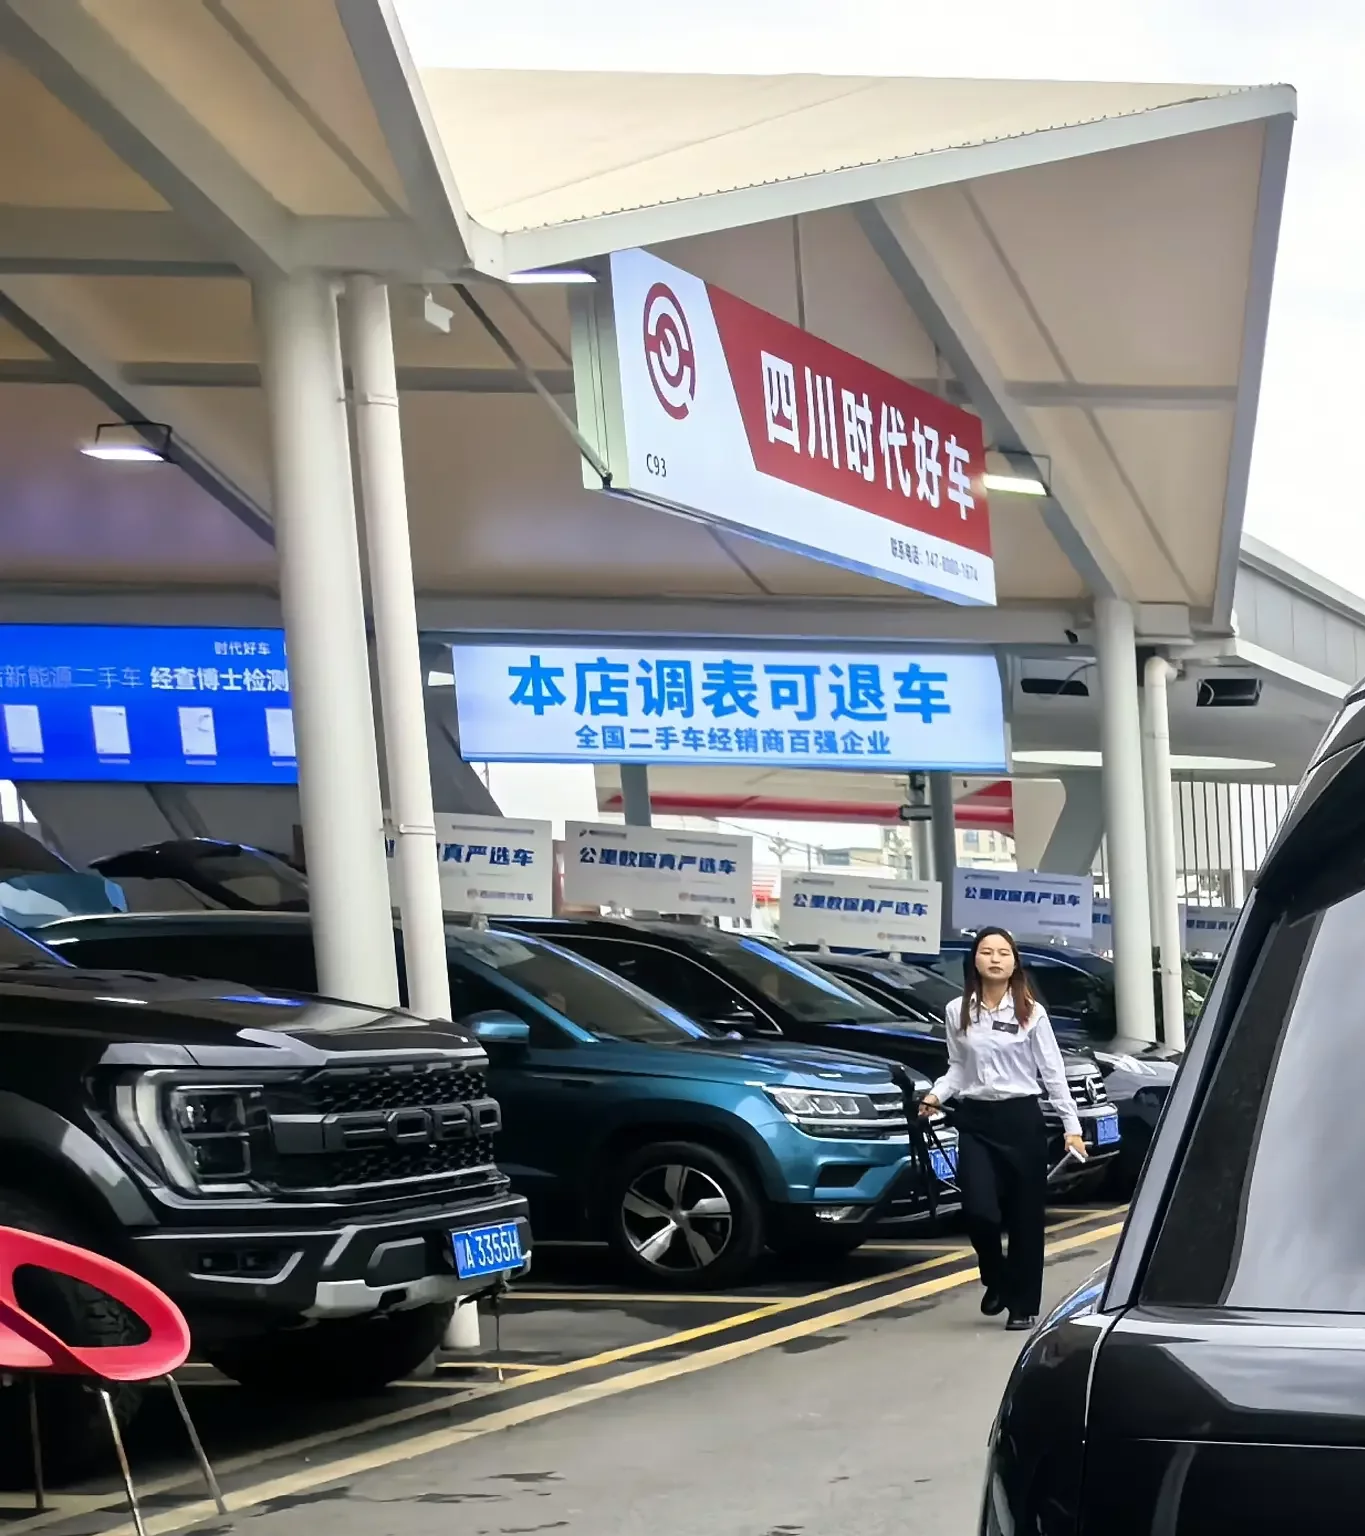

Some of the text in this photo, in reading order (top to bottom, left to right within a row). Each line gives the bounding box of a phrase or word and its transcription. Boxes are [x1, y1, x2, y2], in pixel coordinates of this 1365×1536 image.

[761, 350, 976, 521] 四川时代好车
[646, 453, 667, 478] C93
[214, 641, 272, 656] 时代好车
[150, 666, 289, 692] 经查博士检测
[508, 655, 951, 723] 本店调表可退车
[575, 724, 891, 755] 全国二手车经销商百强企业
[436, 843, 535, 867] 真严选车
